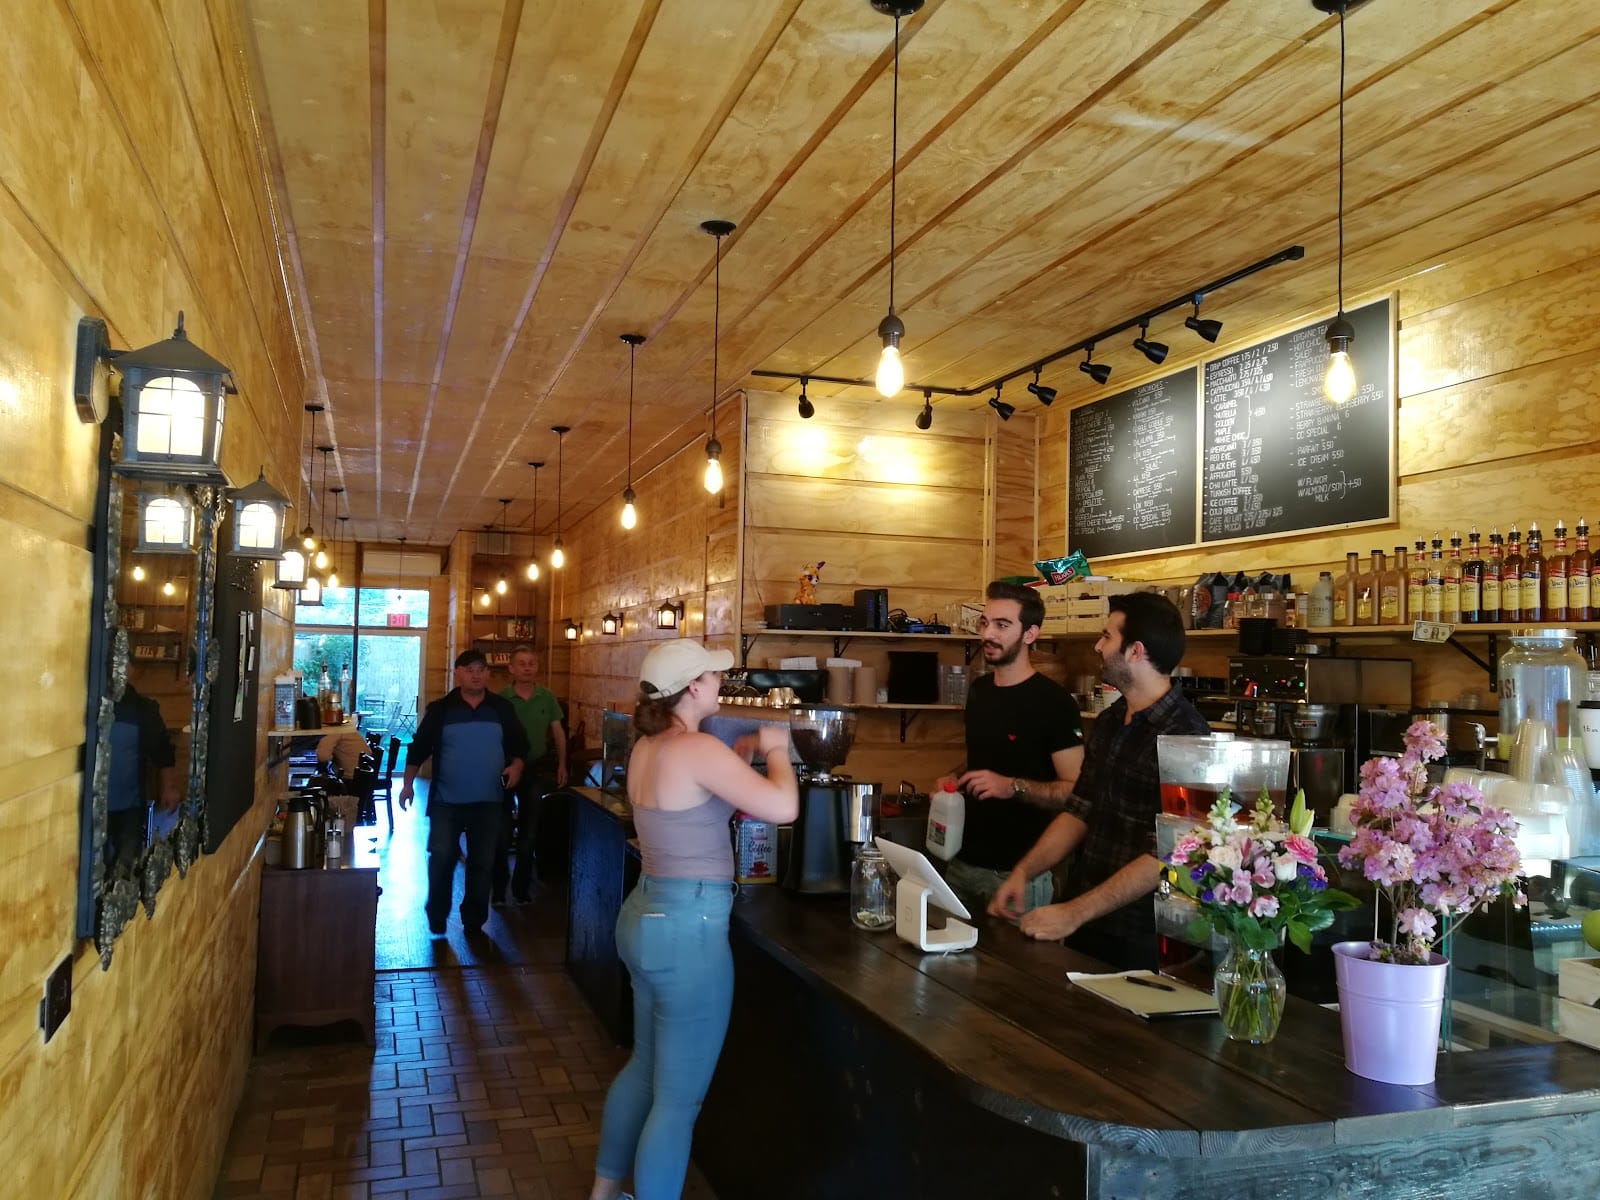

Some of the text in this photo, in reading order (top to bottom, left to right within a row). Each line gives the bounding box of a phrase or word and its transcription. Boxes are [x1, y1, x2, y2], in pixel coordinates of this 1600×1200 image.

[1293, 329, 1316, 343] ORGANIC
[1222, 355, 1239, 367] COFFEE
[1209, 367, 1233, 380] ESPRESSO
[1295, 365, 1314, 377] FRESH
[1210, 374, 1236, 387] MACCHIATO
[1210, 382, 1239, 396] CAPPUCCINO
[1210, 393, 1226, 403] LATTE
[1296, 419, 1316, 430] BERRY
[1306, 426, 1328, 437] SPECIAL
[1209, 442, 1236, 454] AMERICANO
[1297, 444, 1319, 455] PARFAIT
[1220, 452, 1231, 461] EYE
[1209, 462, 1225, 471] BLACK
[1226, 460, 1236, 468] EYE
[1209, 482, 1220, 490] CHAI
[1221, 480, 1237, 488] LATTE
[1209, 488, 1231, 498] TURKISH
[1232, 486, 1251, 496] COFFEE
[1315, 493, 1328, 501] MILK
[1218, 497, 1238, 508] COFFEE
[1209, 508, 1222, 516] COLD
[1224, 506, 1238, 515] BREW
